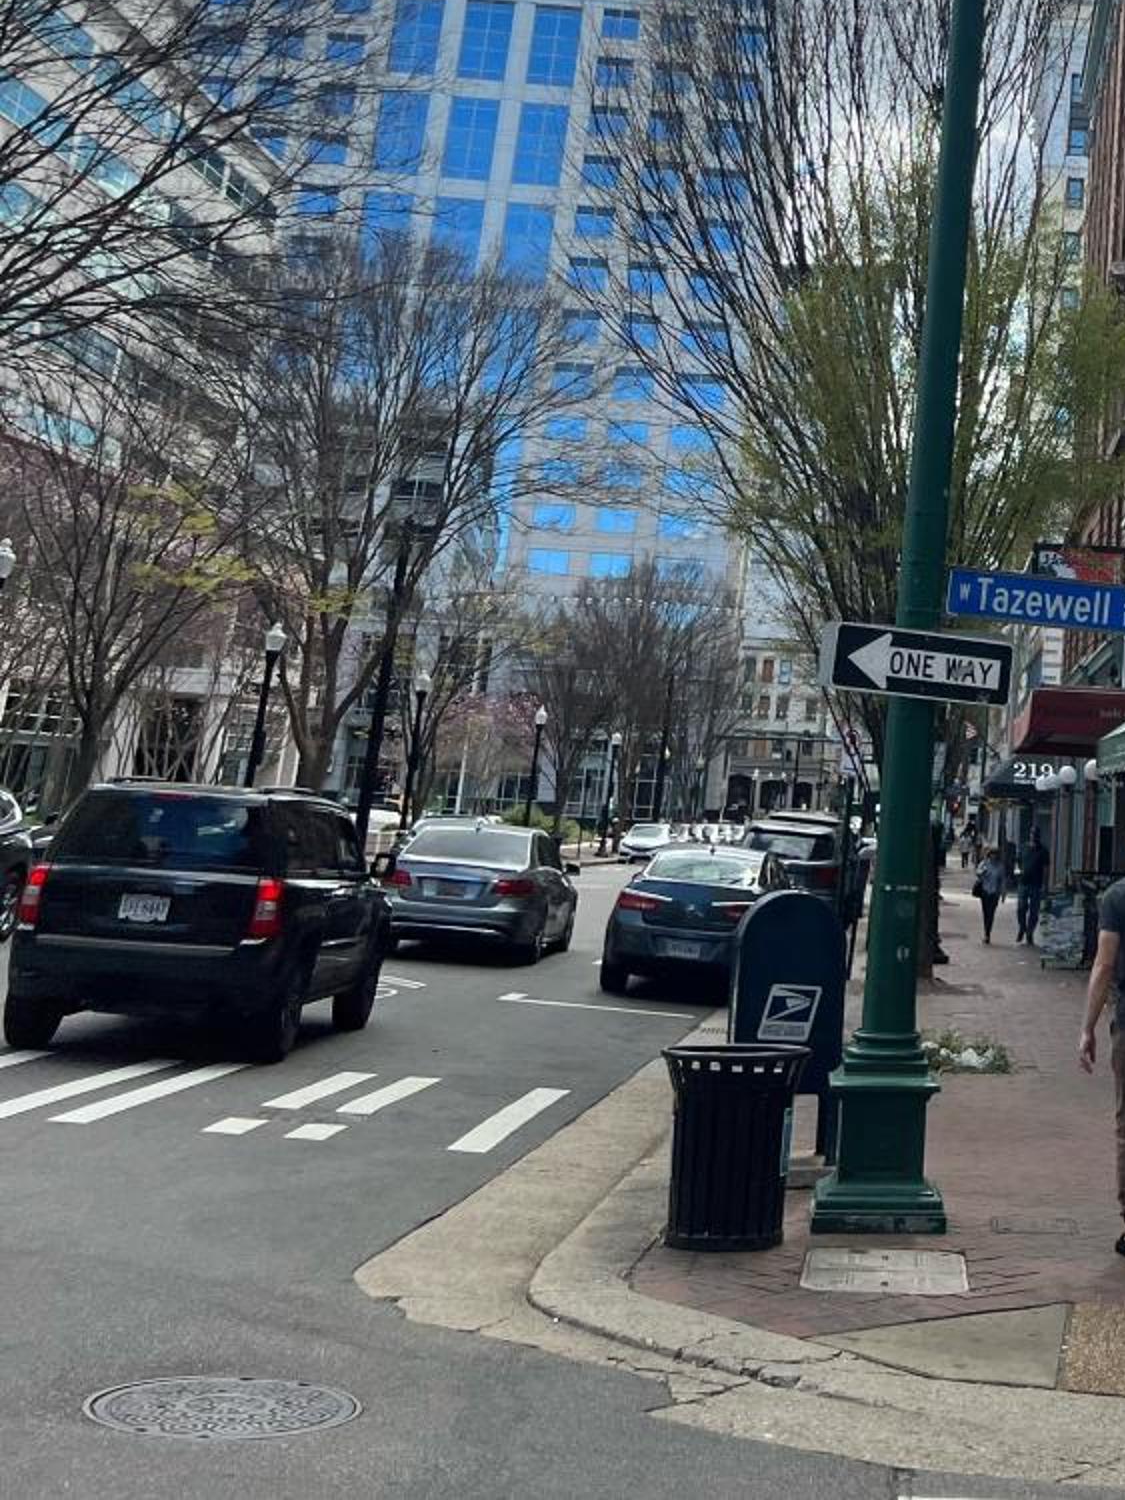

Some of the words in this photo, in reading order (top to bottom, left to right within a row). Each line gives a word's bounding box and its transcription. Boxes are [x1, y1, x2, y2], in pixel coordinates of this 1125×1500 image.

[959, 580, 971, 600] W
[977, 577, 1111, 626] Tazewell
[889, 650, 935, 679] ONE
[945, 655, 993, 685] WAY
[1013, 761, 1053, 779] 219
